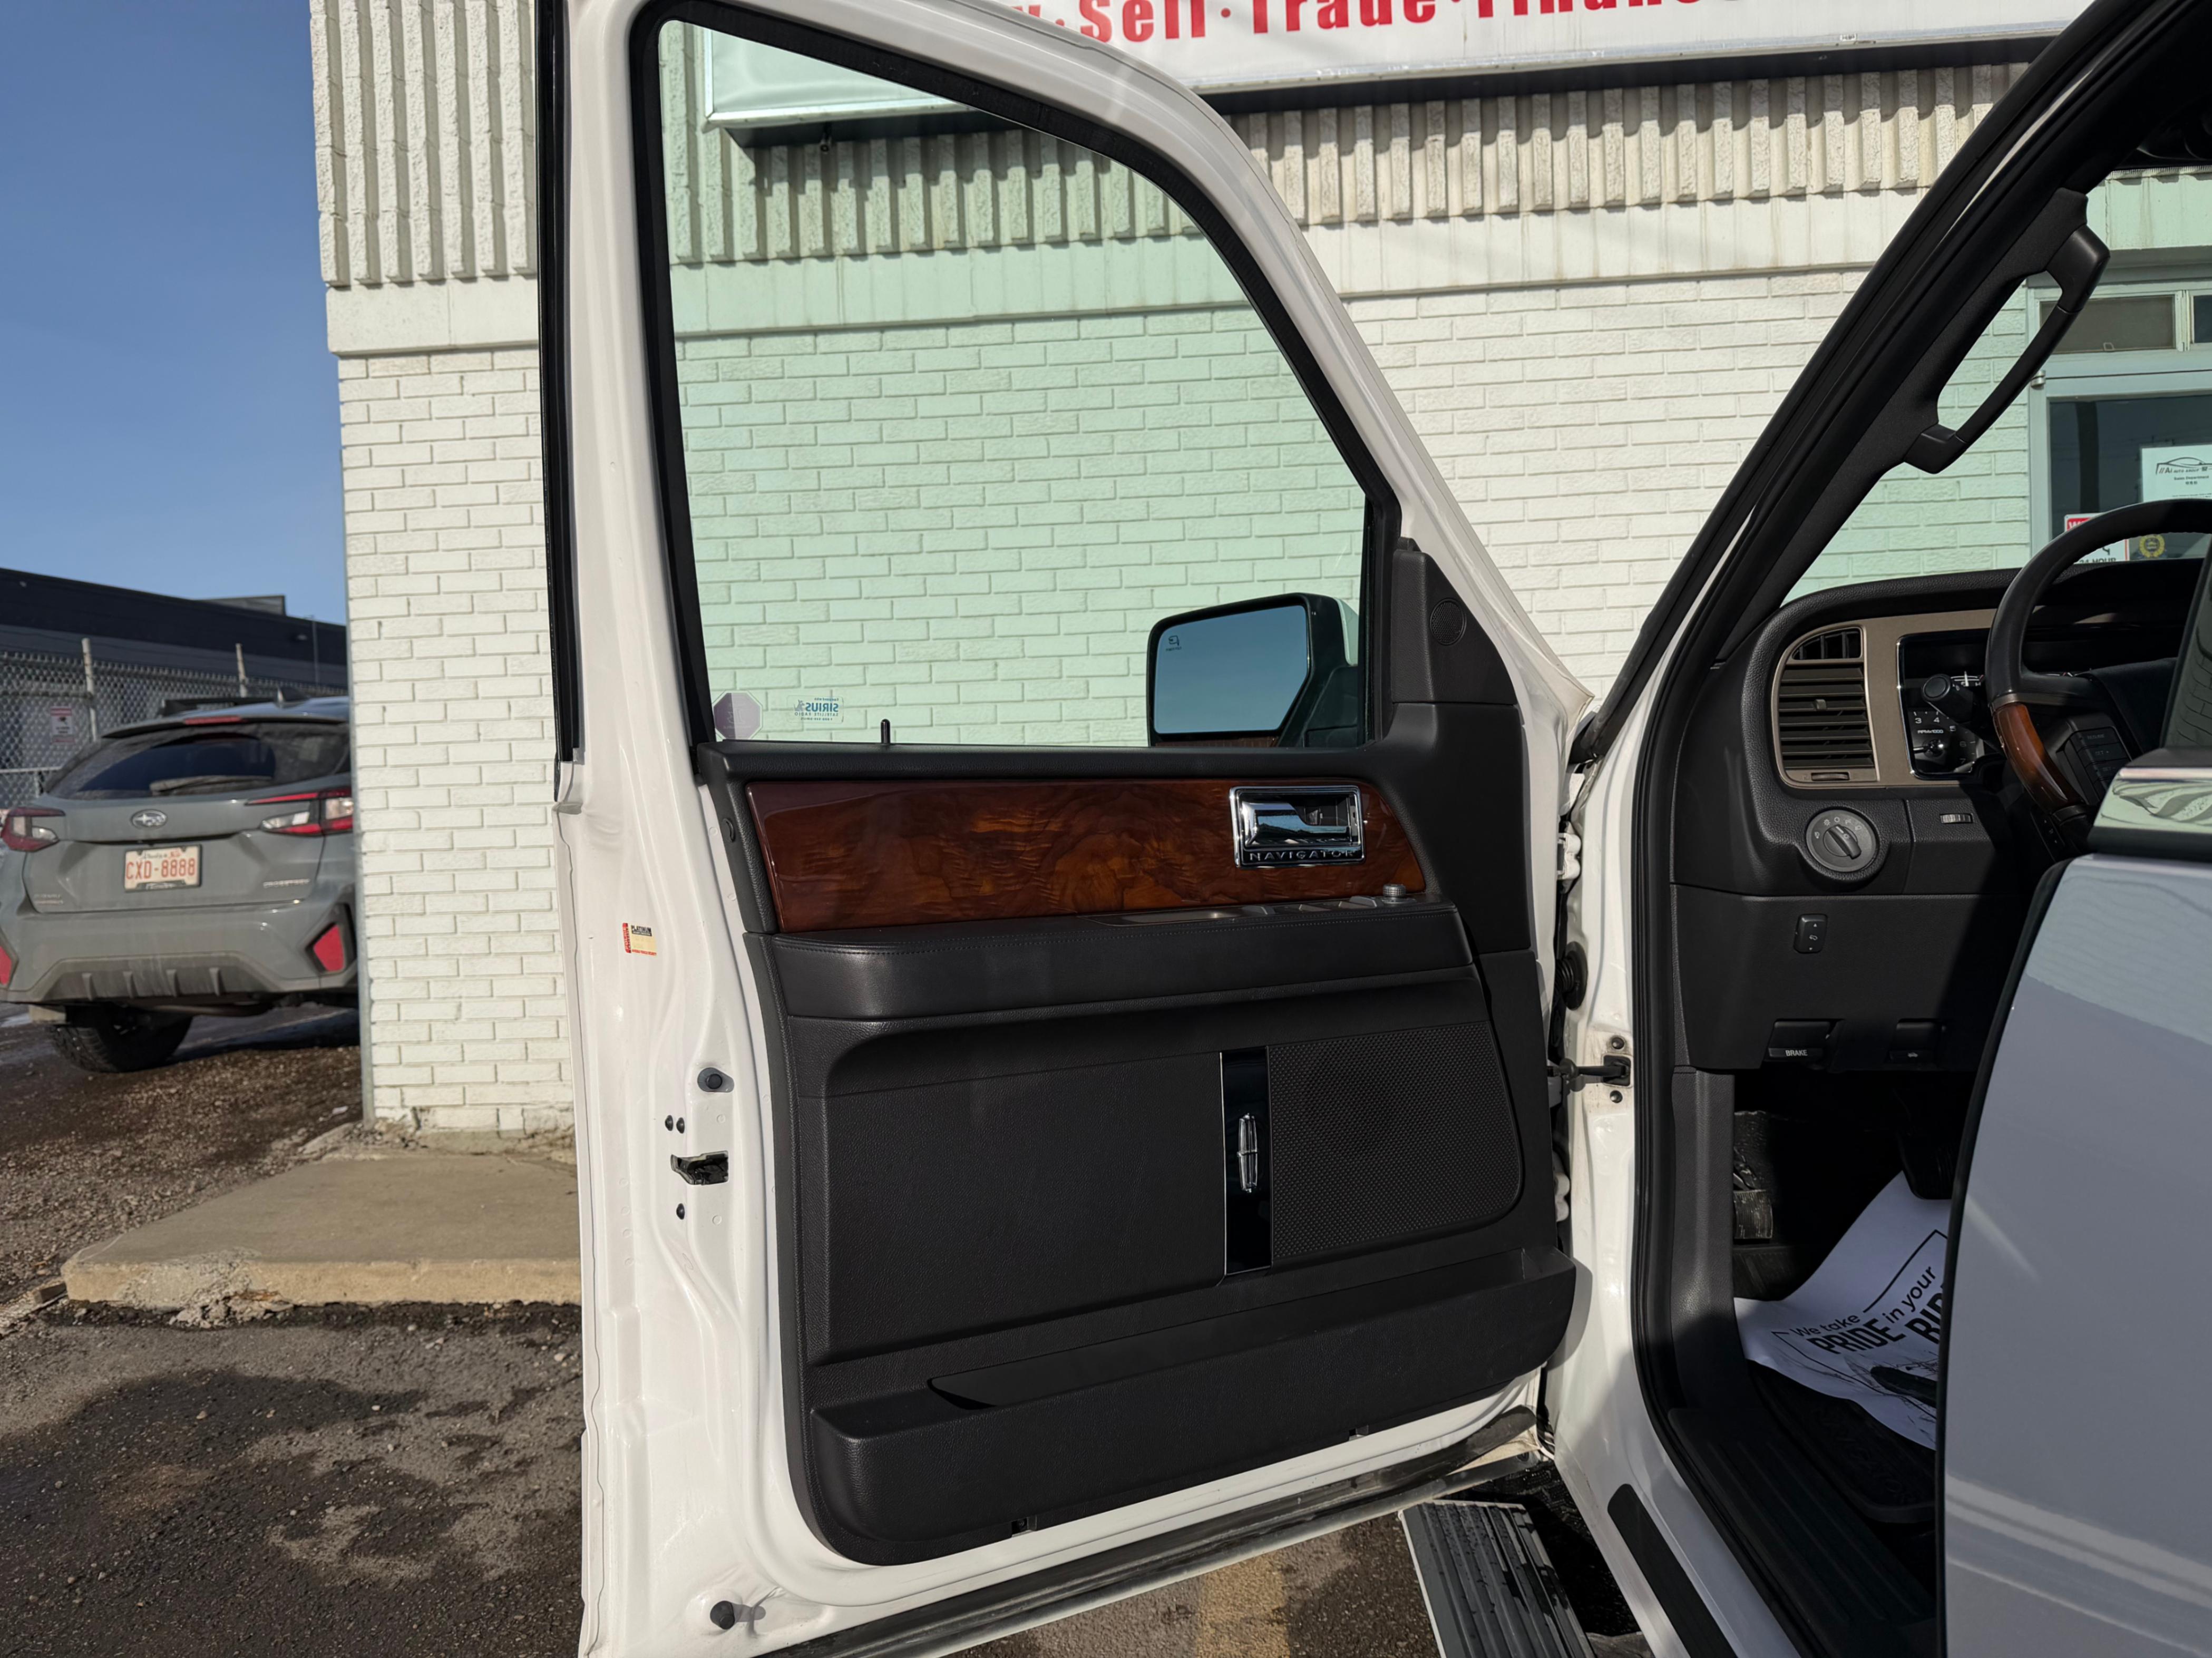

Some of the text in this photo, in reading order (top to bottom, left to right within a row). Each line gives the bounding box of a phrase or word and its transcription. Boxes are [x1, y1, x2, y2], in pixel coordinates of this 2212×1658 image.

[1078, 0, 1205, 43] Sell
[125, 857, 196, 879] CXD-8888
[1250, 850, 1356, 861] NAVIGATOR
[1789, 1314, 1860, 1337] We take
[1806, 1266, 1936, 1354] PRIDE in your
[1904, 1282, 1944, 1344] RI
